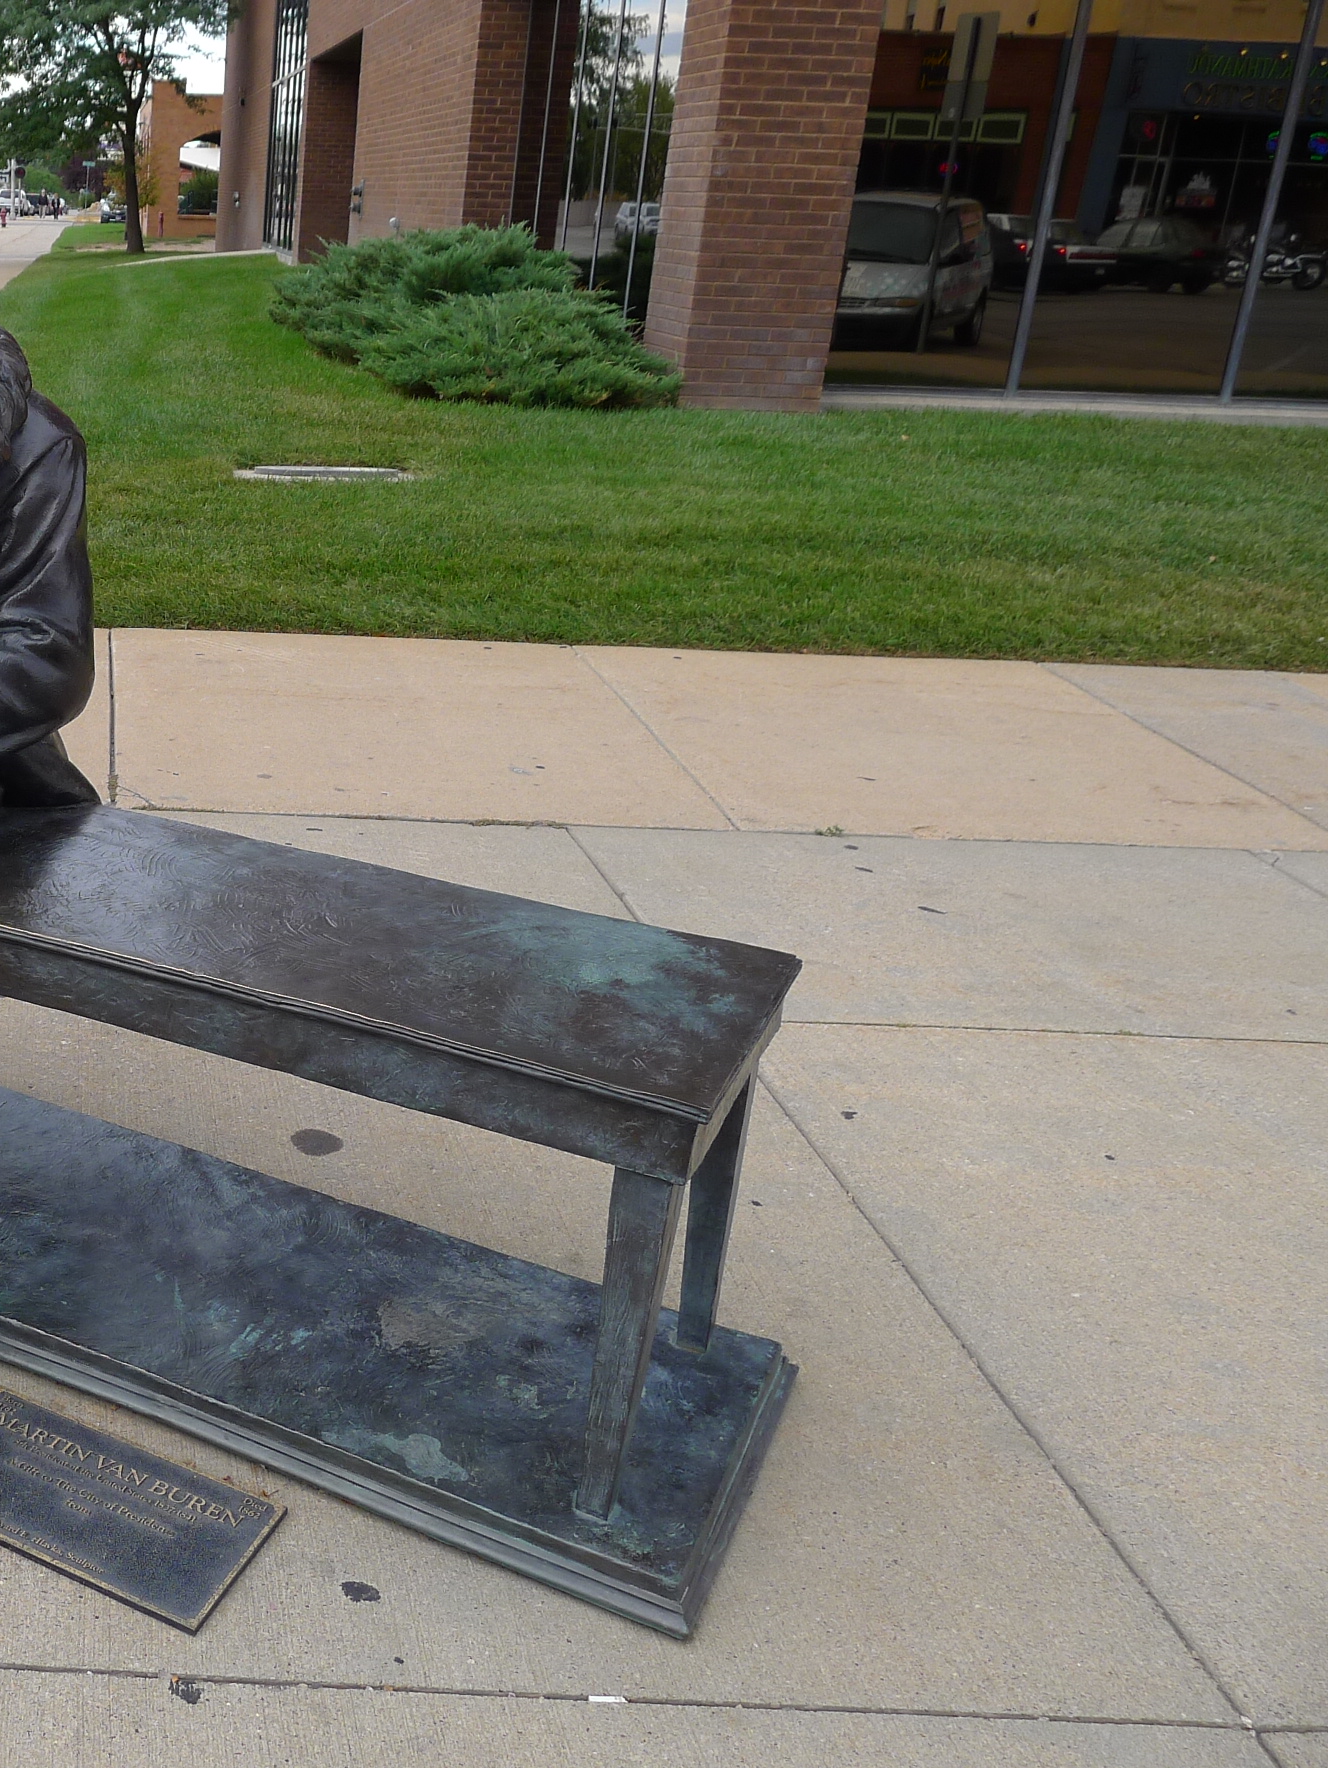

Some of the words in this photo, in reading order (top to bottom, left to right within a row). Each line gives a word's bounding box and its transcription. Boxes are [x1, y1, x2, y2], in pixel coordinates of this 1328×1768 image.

[96, 1473, 128, 1493] United
[96, 1454, 150, 1488] VAN
[147, 1478, 246, 1529] BUREN
[55, 1477, 78, 1494] The
[78, 1487, 104, 1506] City
[103, 1500, 119, 1512] of
[118, 1505, 178, 1539] Presidents
[238, 1505, 262, 1519] 1862
[243, 1497, 268, 1512] Died
[66, 1551, 106, 1575] Sculptor
